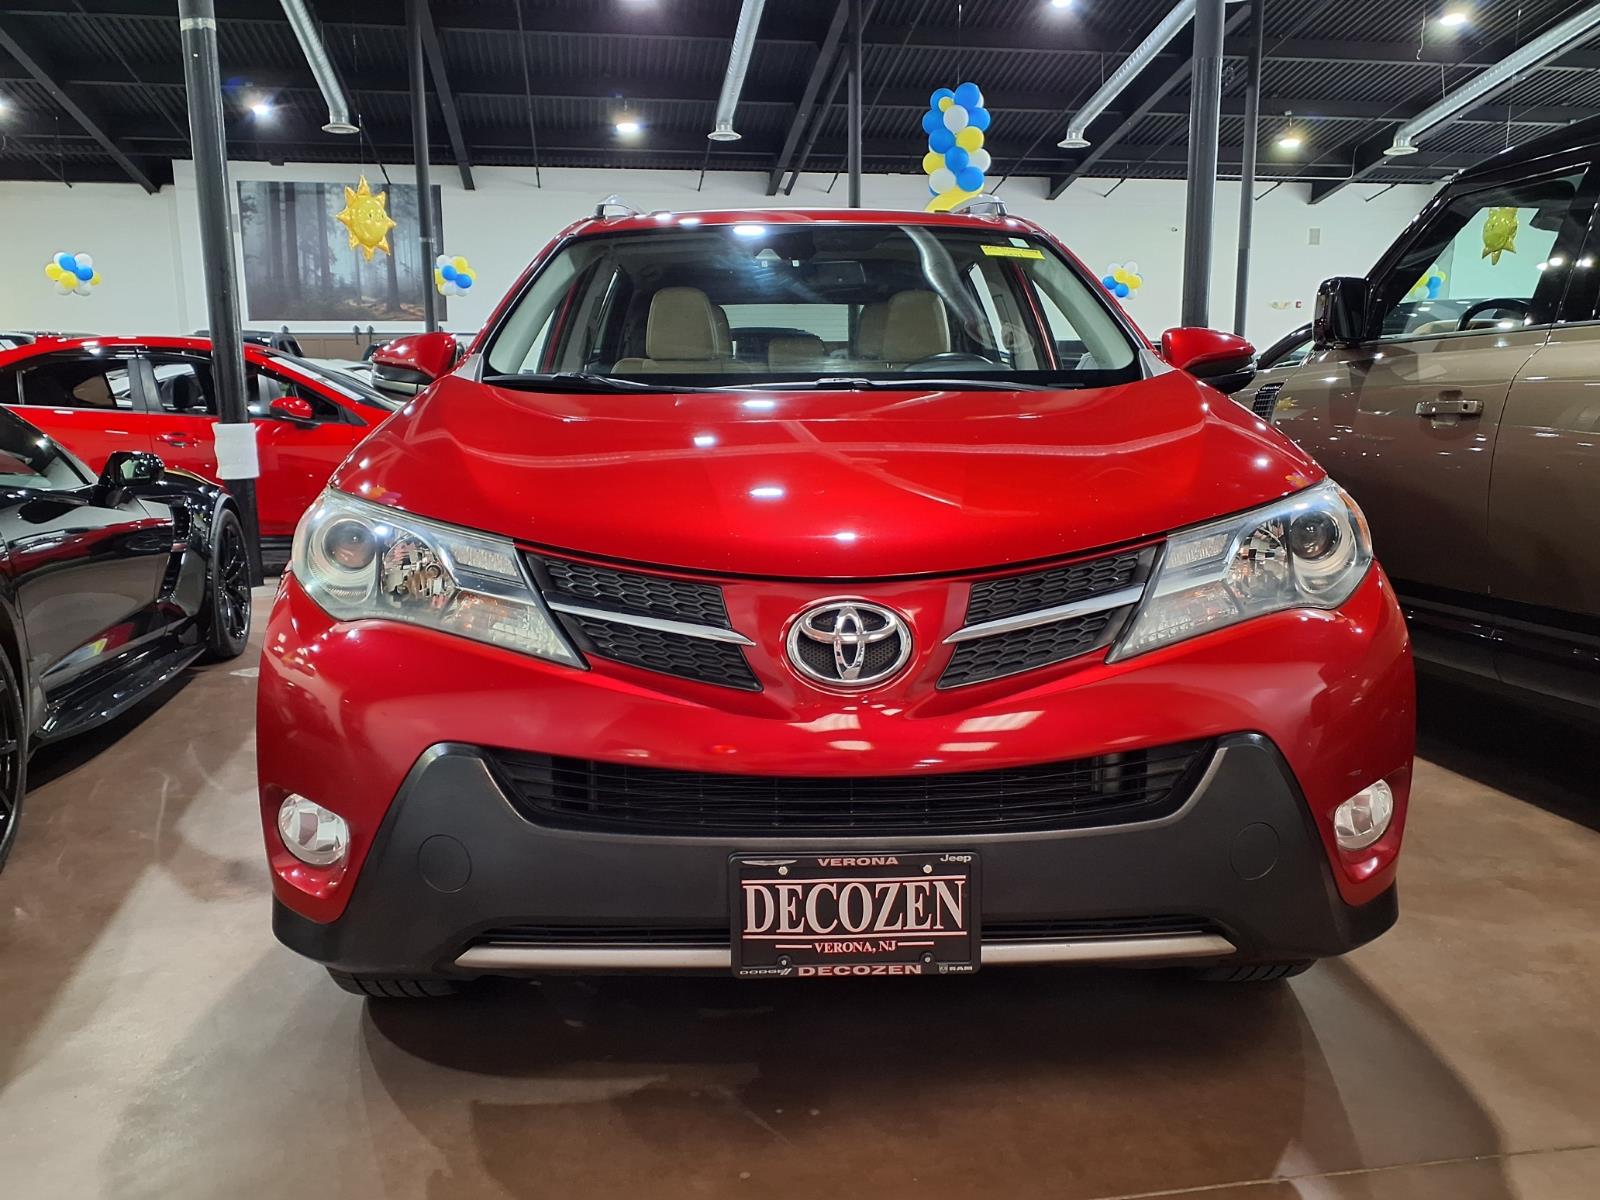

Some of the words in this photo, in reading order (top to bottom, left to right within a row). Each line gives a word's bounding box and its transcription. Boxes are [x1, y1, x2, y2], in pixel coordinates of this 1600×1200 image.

[817, 856, 899, 867] VERONA
[940, 853, 972, 863] Jeep
[743, 880, 966, 933] DECOZEN
[814, 941, 876, 953] VERONA,
[879, 940, 897, 951] NJ
[798, 964, 922, 976] DECOZEN
